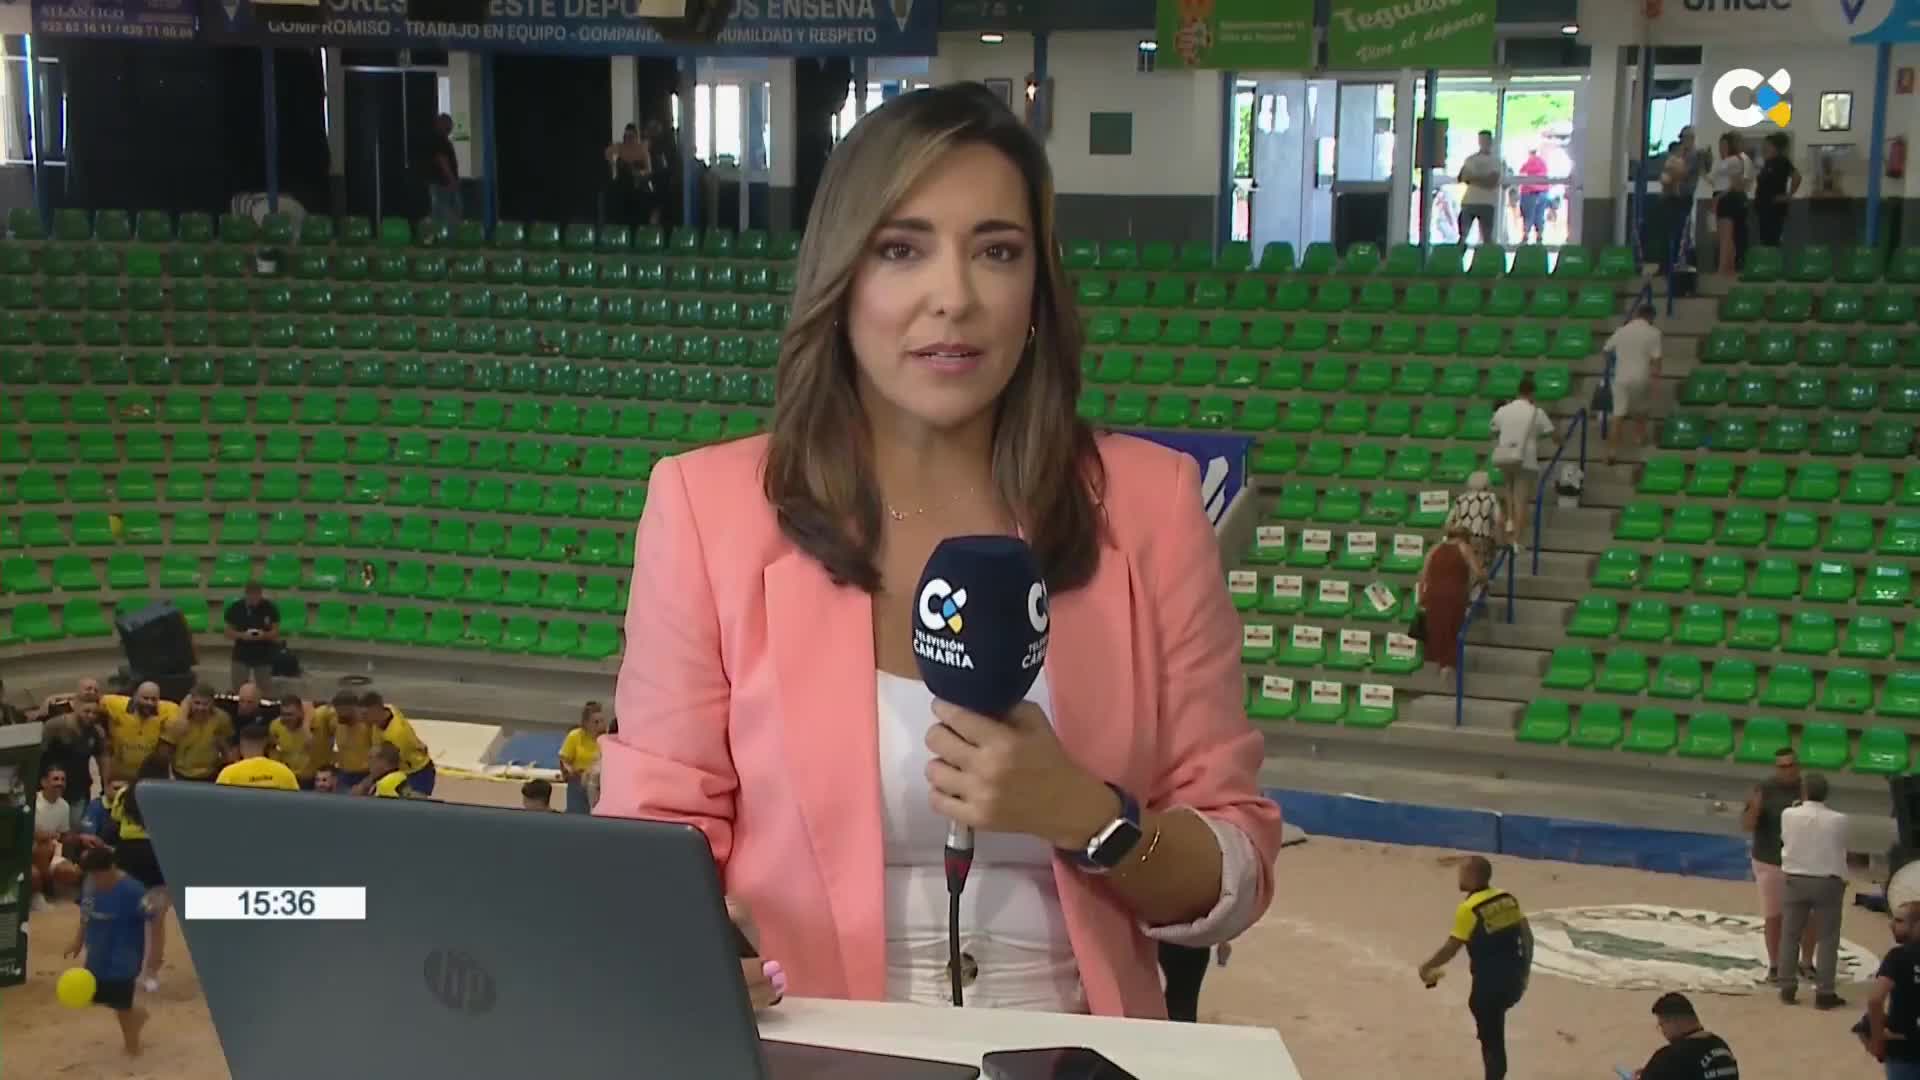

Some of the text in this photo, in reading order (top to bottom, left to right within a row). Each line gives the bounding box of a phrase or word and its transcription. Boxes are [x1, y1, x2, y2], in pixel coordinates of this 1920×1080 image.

[267, 19, 391, 37] COMPROMISO
[407, 21, 479, 39] TRABAJO
[483, 24, 503, 40] EN
[507, 24, 567, 44] EQUIPO
[808, 26, 877, 44] RESPETO
[915, 628, 965, 653] TELEVISIÓN
[913, 638, 975, 670] CANARIA
